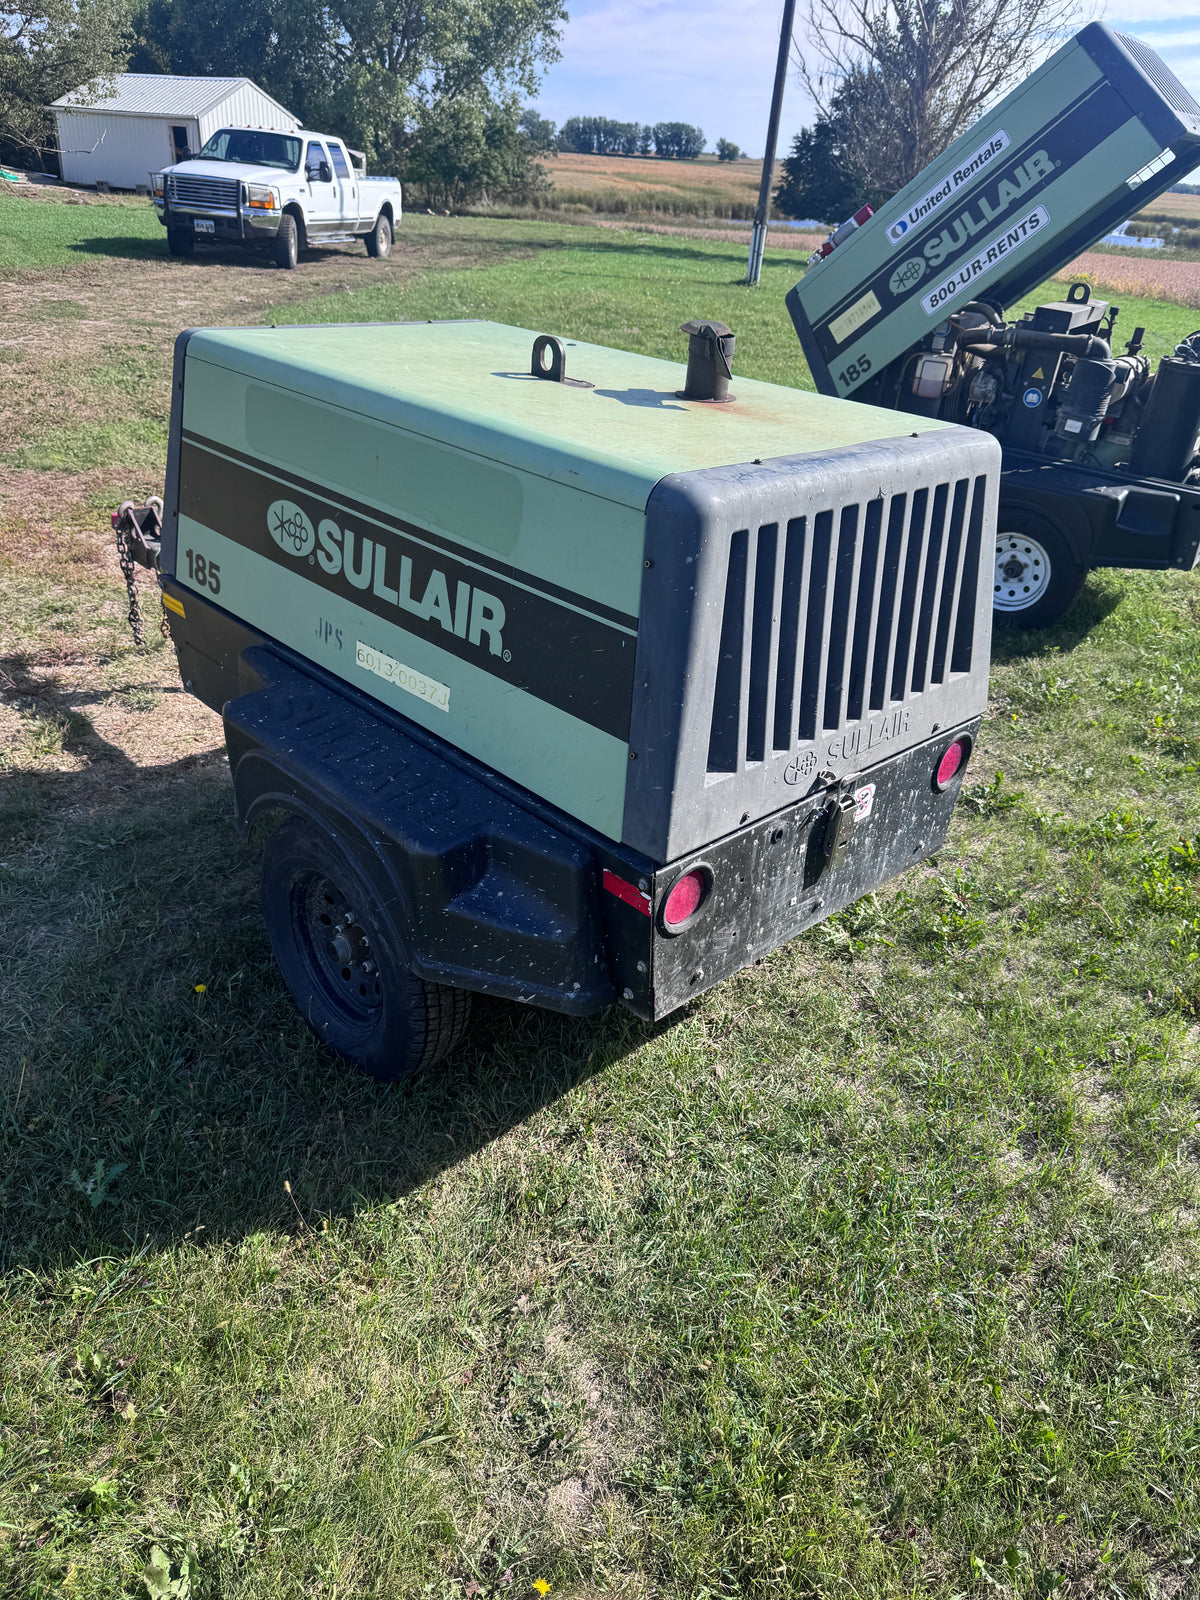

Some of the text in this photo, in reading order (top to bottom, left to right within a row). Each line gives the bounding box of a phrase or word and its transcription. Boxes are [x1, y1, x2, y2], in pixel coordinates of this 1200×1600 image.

[907, 138, 1004, 225] United Rentals
[923, 148, 1057, 267] SULLAIR
[929, 212, 1041, 308] 800-UR-RENTS
[837, 352, 872, 388] 185
[185, 547, 221, 595] 185
[316, 518, 507, 658] SULLAIR
[314, 616, 343, 651] JPS
[826, 707, 912, 767] SULLAIR
